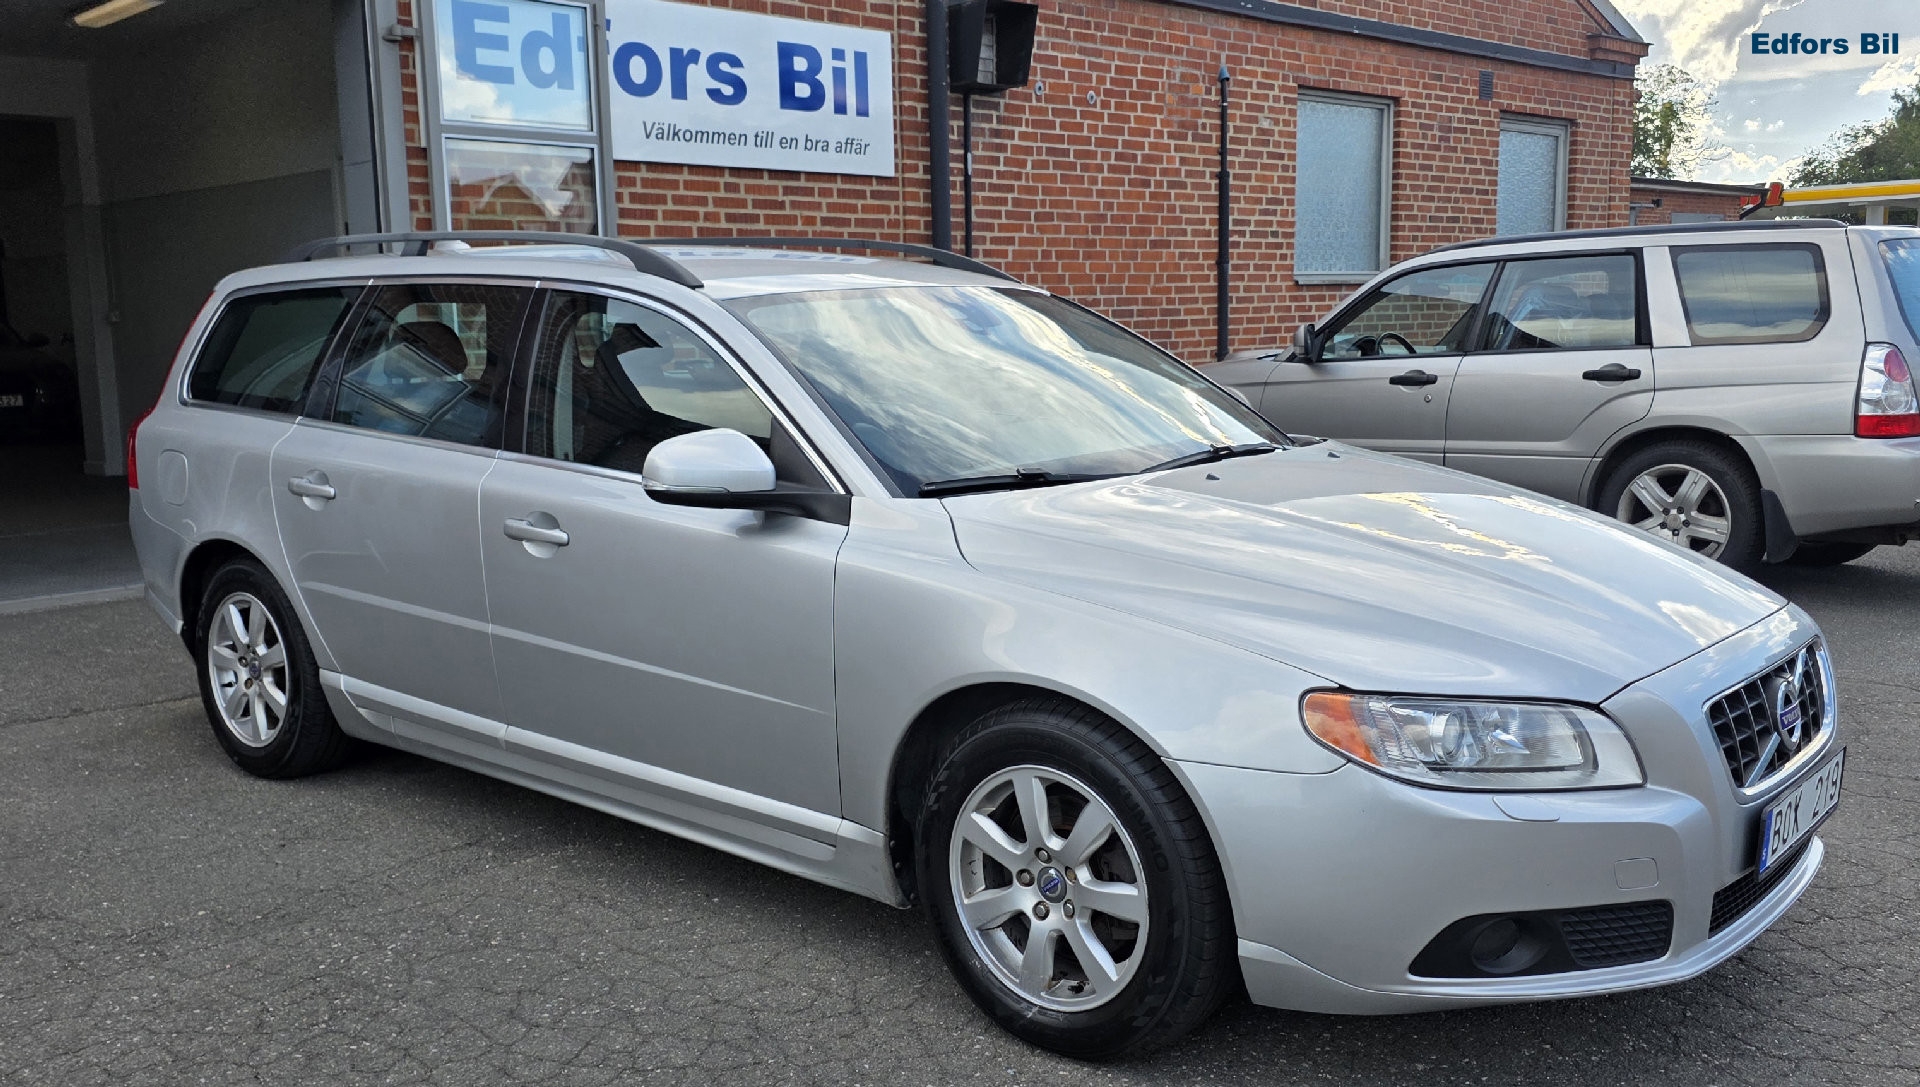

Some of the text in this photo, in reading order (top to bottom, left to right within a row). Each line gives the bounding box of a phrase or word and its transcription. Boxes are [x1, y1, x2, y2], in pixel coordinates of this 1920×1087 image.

[777, 41, 870, 118] Bil
[642, 120, 870, 156] Välkommen till en bra affär
[1812, 760, 1840, 819] 219
